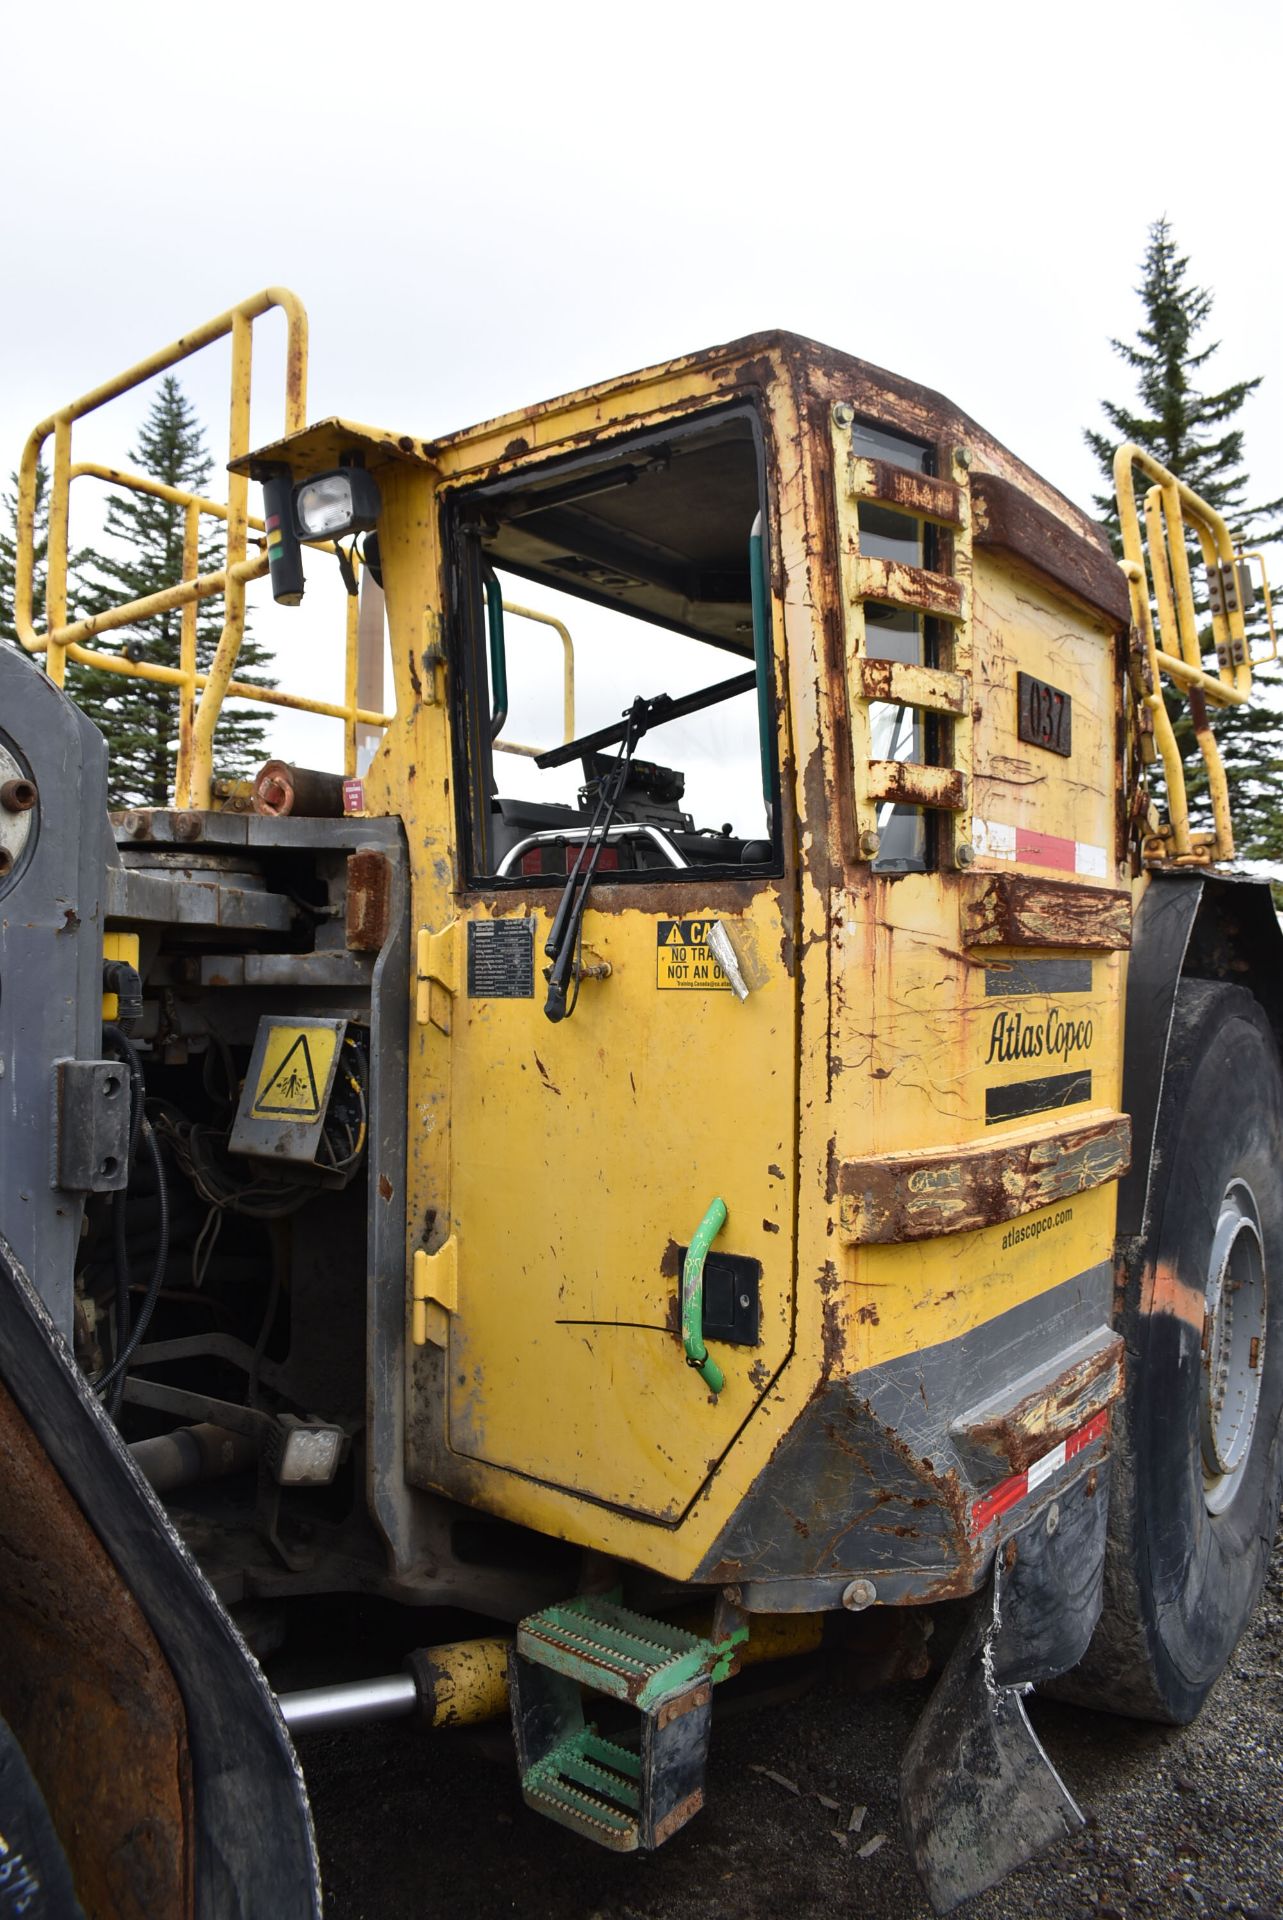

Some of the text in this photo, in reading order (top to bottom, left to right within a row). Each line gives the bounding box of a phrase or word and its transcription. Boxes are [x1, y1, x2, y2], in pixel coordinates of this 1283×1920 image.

[1030, 681, 1065, 749] 037
[671, 947, 717, 962] NO TRA
[667, 965, 689, 979] NOT
[693, 965, 709, 979] AN
[1002, 1207, 1073, 1251] atlascopco.com
